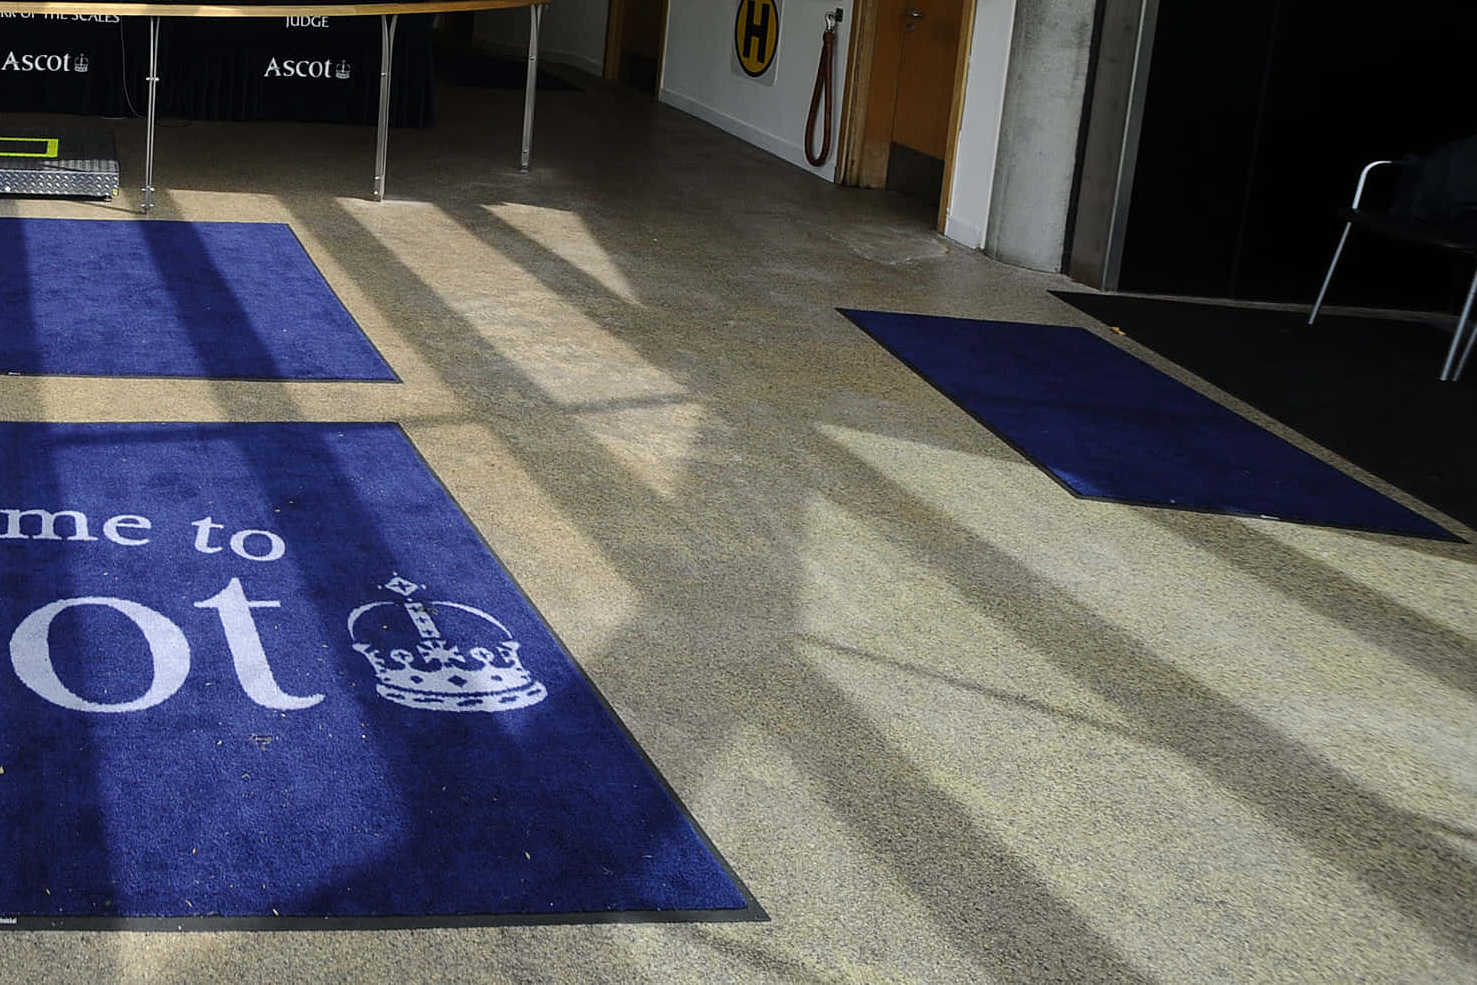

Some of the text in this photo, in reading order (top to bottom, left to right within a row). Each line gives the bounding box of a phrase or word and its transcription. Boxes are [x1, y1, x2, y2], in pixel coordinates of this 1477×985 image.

[285, 15, 330, 28] JUDGE
[742, 0, 771, 64] H
[191, 514, 286, 562] to
